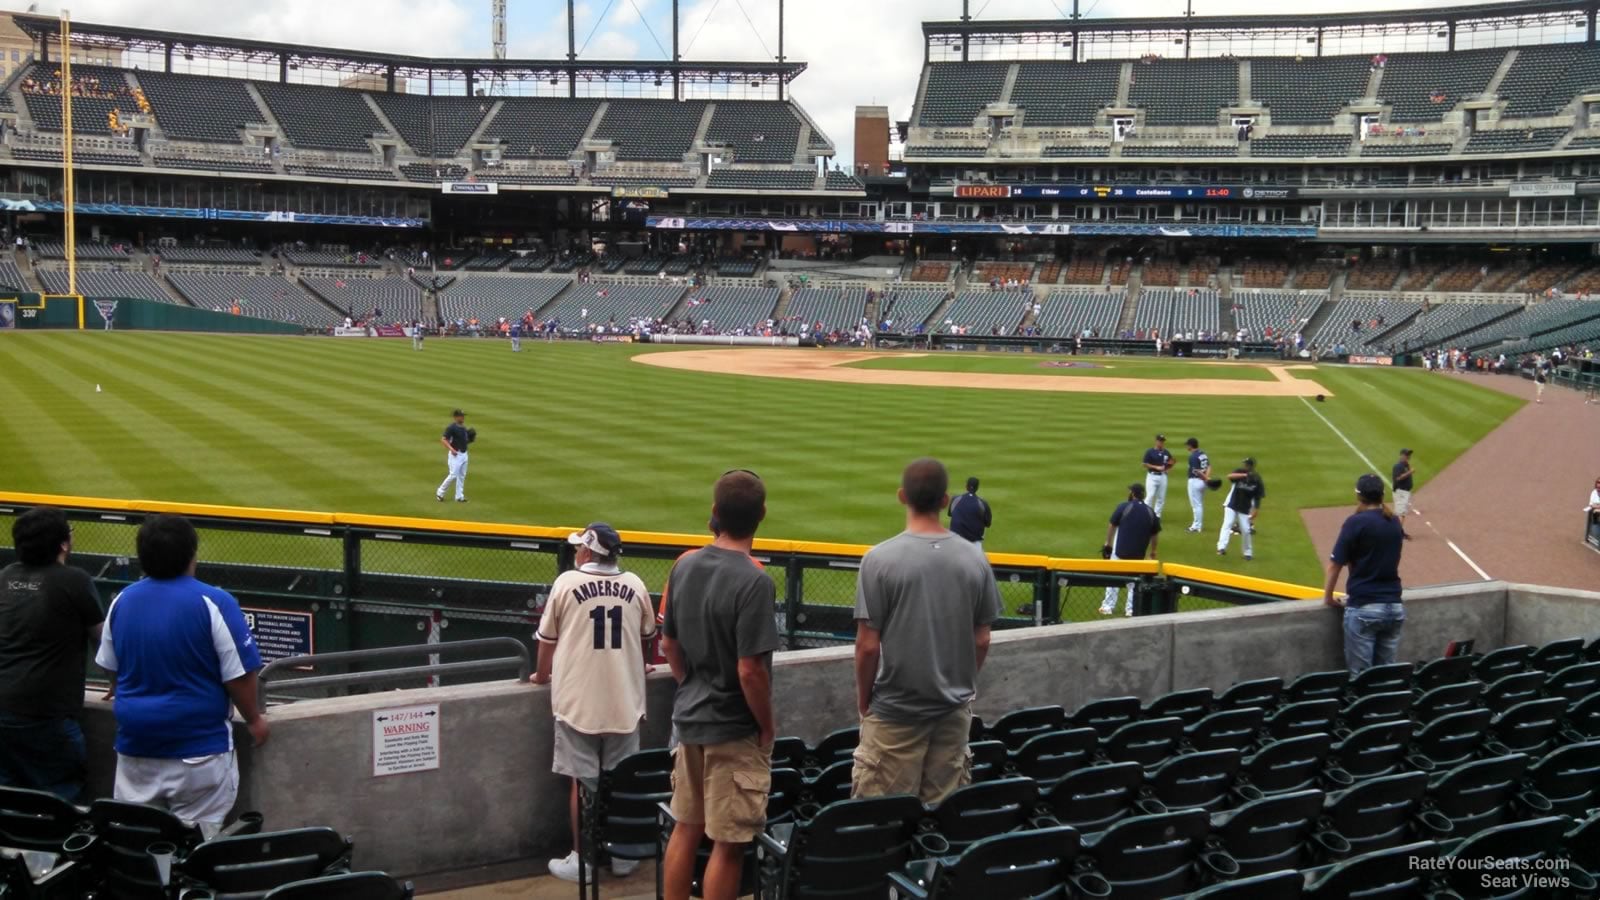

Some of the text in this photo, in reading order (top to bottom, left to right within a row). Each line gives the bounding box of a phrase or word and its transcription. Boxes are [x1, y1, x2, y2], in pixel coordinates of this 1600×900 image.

[961, 187, 1002, 196] LIPARI
[572, 580, 635, 604] ANDERSON
[590, 606, 622, 649] 11
[391, 711, 423, 722] 147/144
[384, 722, 430, 735] WARNING
